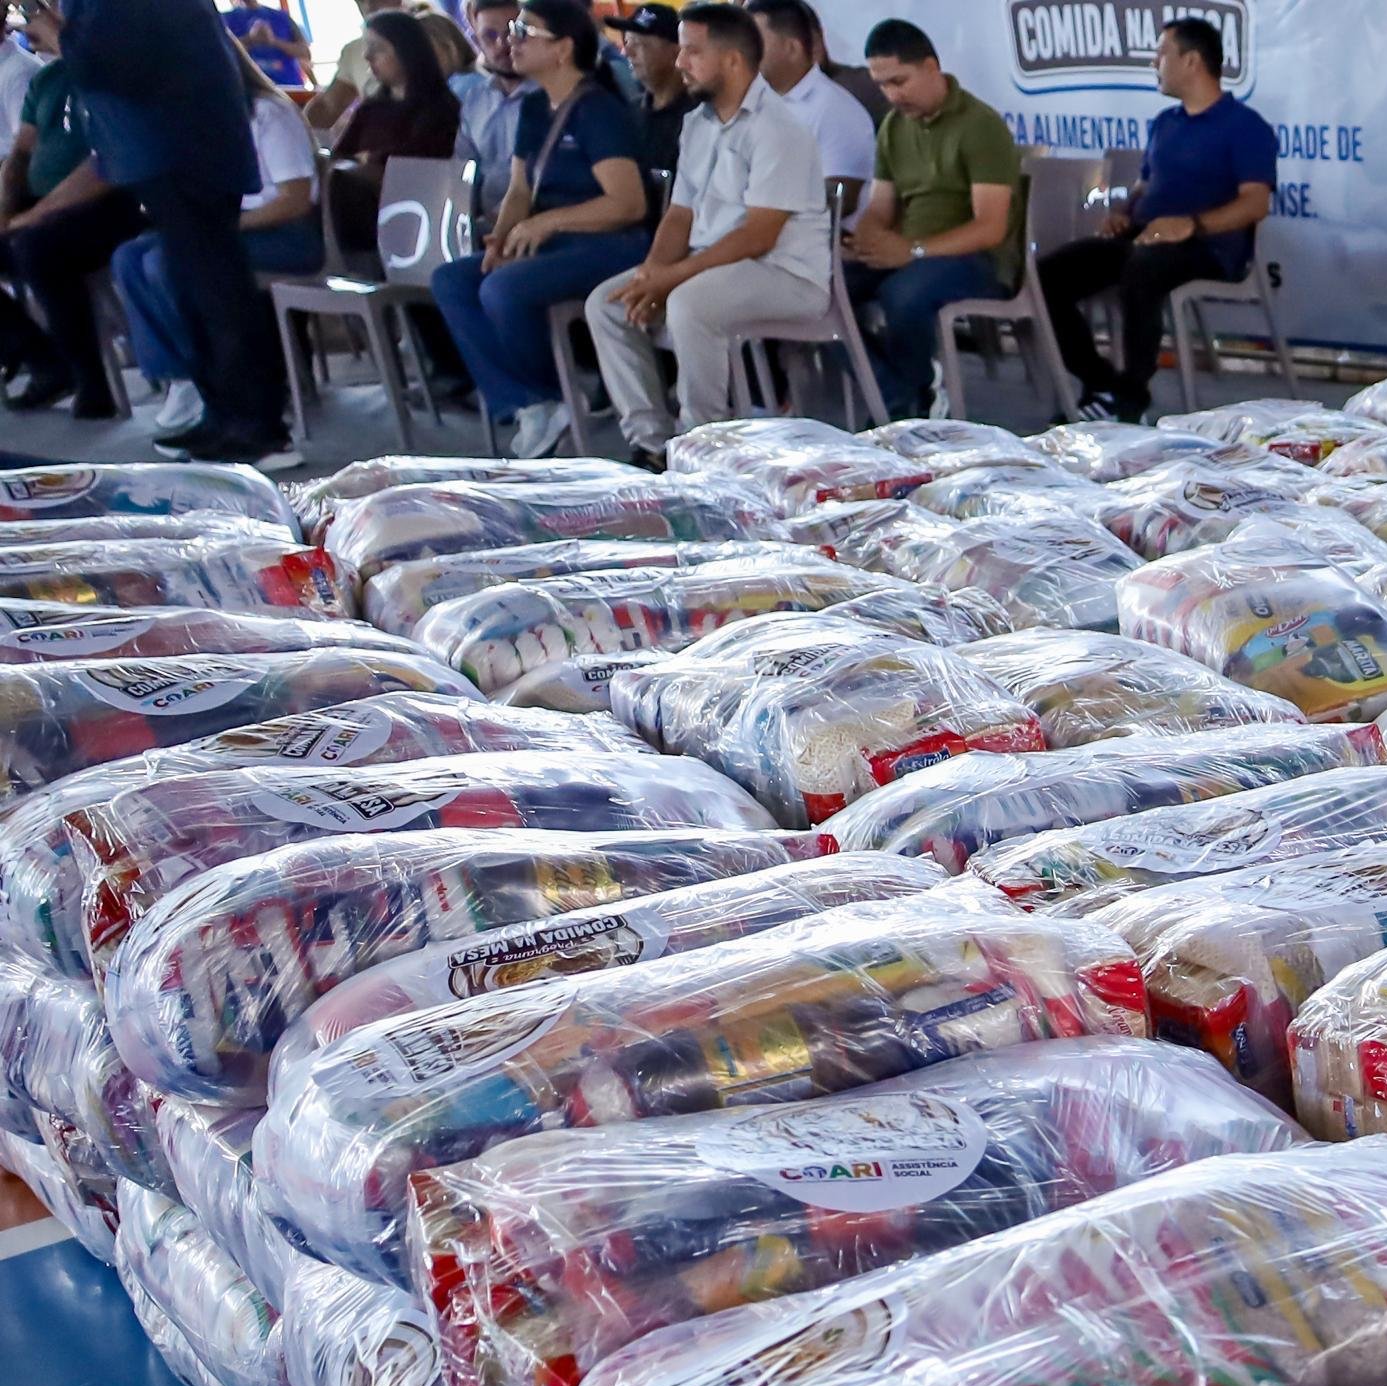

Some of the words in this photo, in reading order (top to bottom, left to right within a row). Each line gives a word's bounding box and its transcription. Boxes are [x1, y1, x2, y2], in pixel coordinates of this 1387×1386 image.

[1017, 4, 1122, 62] COMIDA
[1126, 9, 1157, 51] NA
[1034, 112, 1140, 149] ALIMENTAR
[1338, 127, 1364, 162] DE
[452, 936, 520, 965] MESA
[779, 1161, 883, 1181] COARI
[891, 1160, 959, 1170] ASSISTÊNCIA
[894, 1169, 932, 1178] SOCIAL
